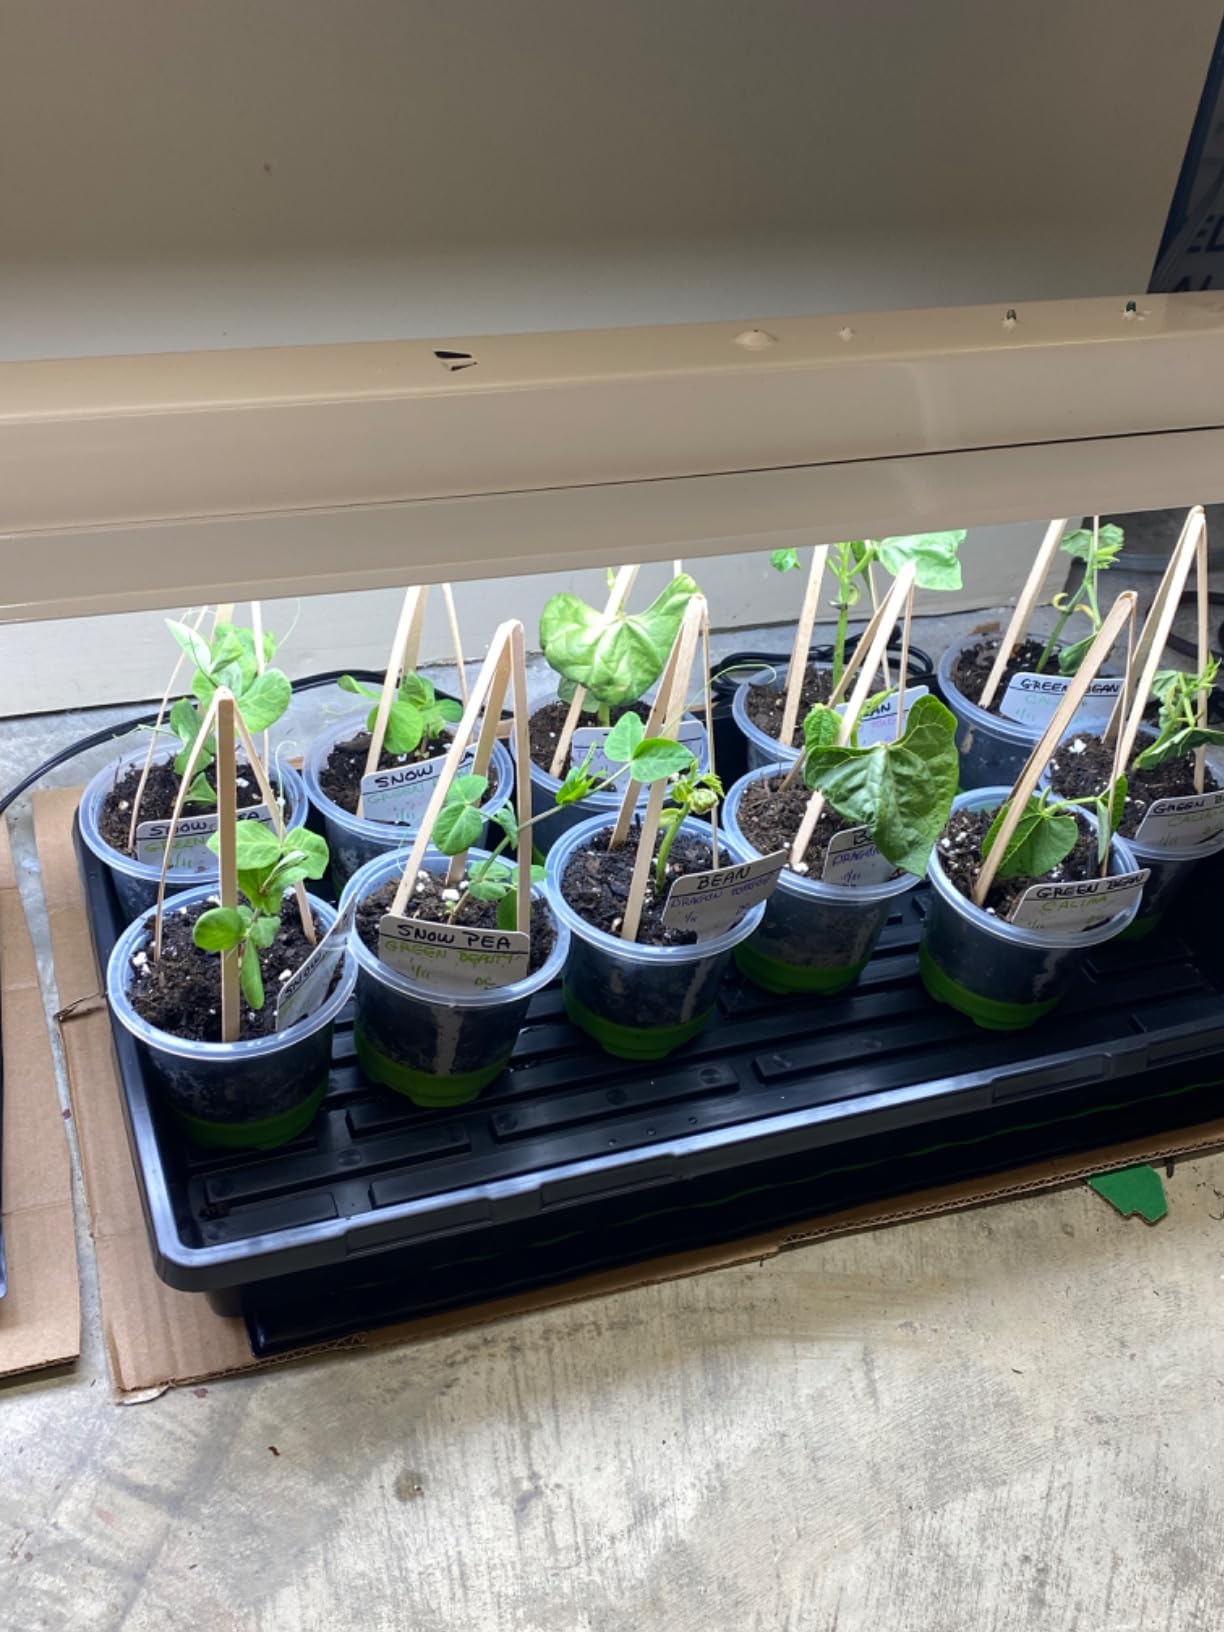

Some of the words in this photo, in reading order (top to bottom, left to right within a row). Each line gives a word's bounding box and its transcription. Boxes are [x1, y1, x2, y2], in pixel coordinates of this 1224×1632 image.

[374, 764, 433, 788] SNOW
[696, 866, 751, 890] BEAN
[1036, 883, 1099, 899] GREEN
[396, 923, 456, 945] SNOW
[461, 930, 512, 950] PEA
[384, 938, 448, 960] GREEN
